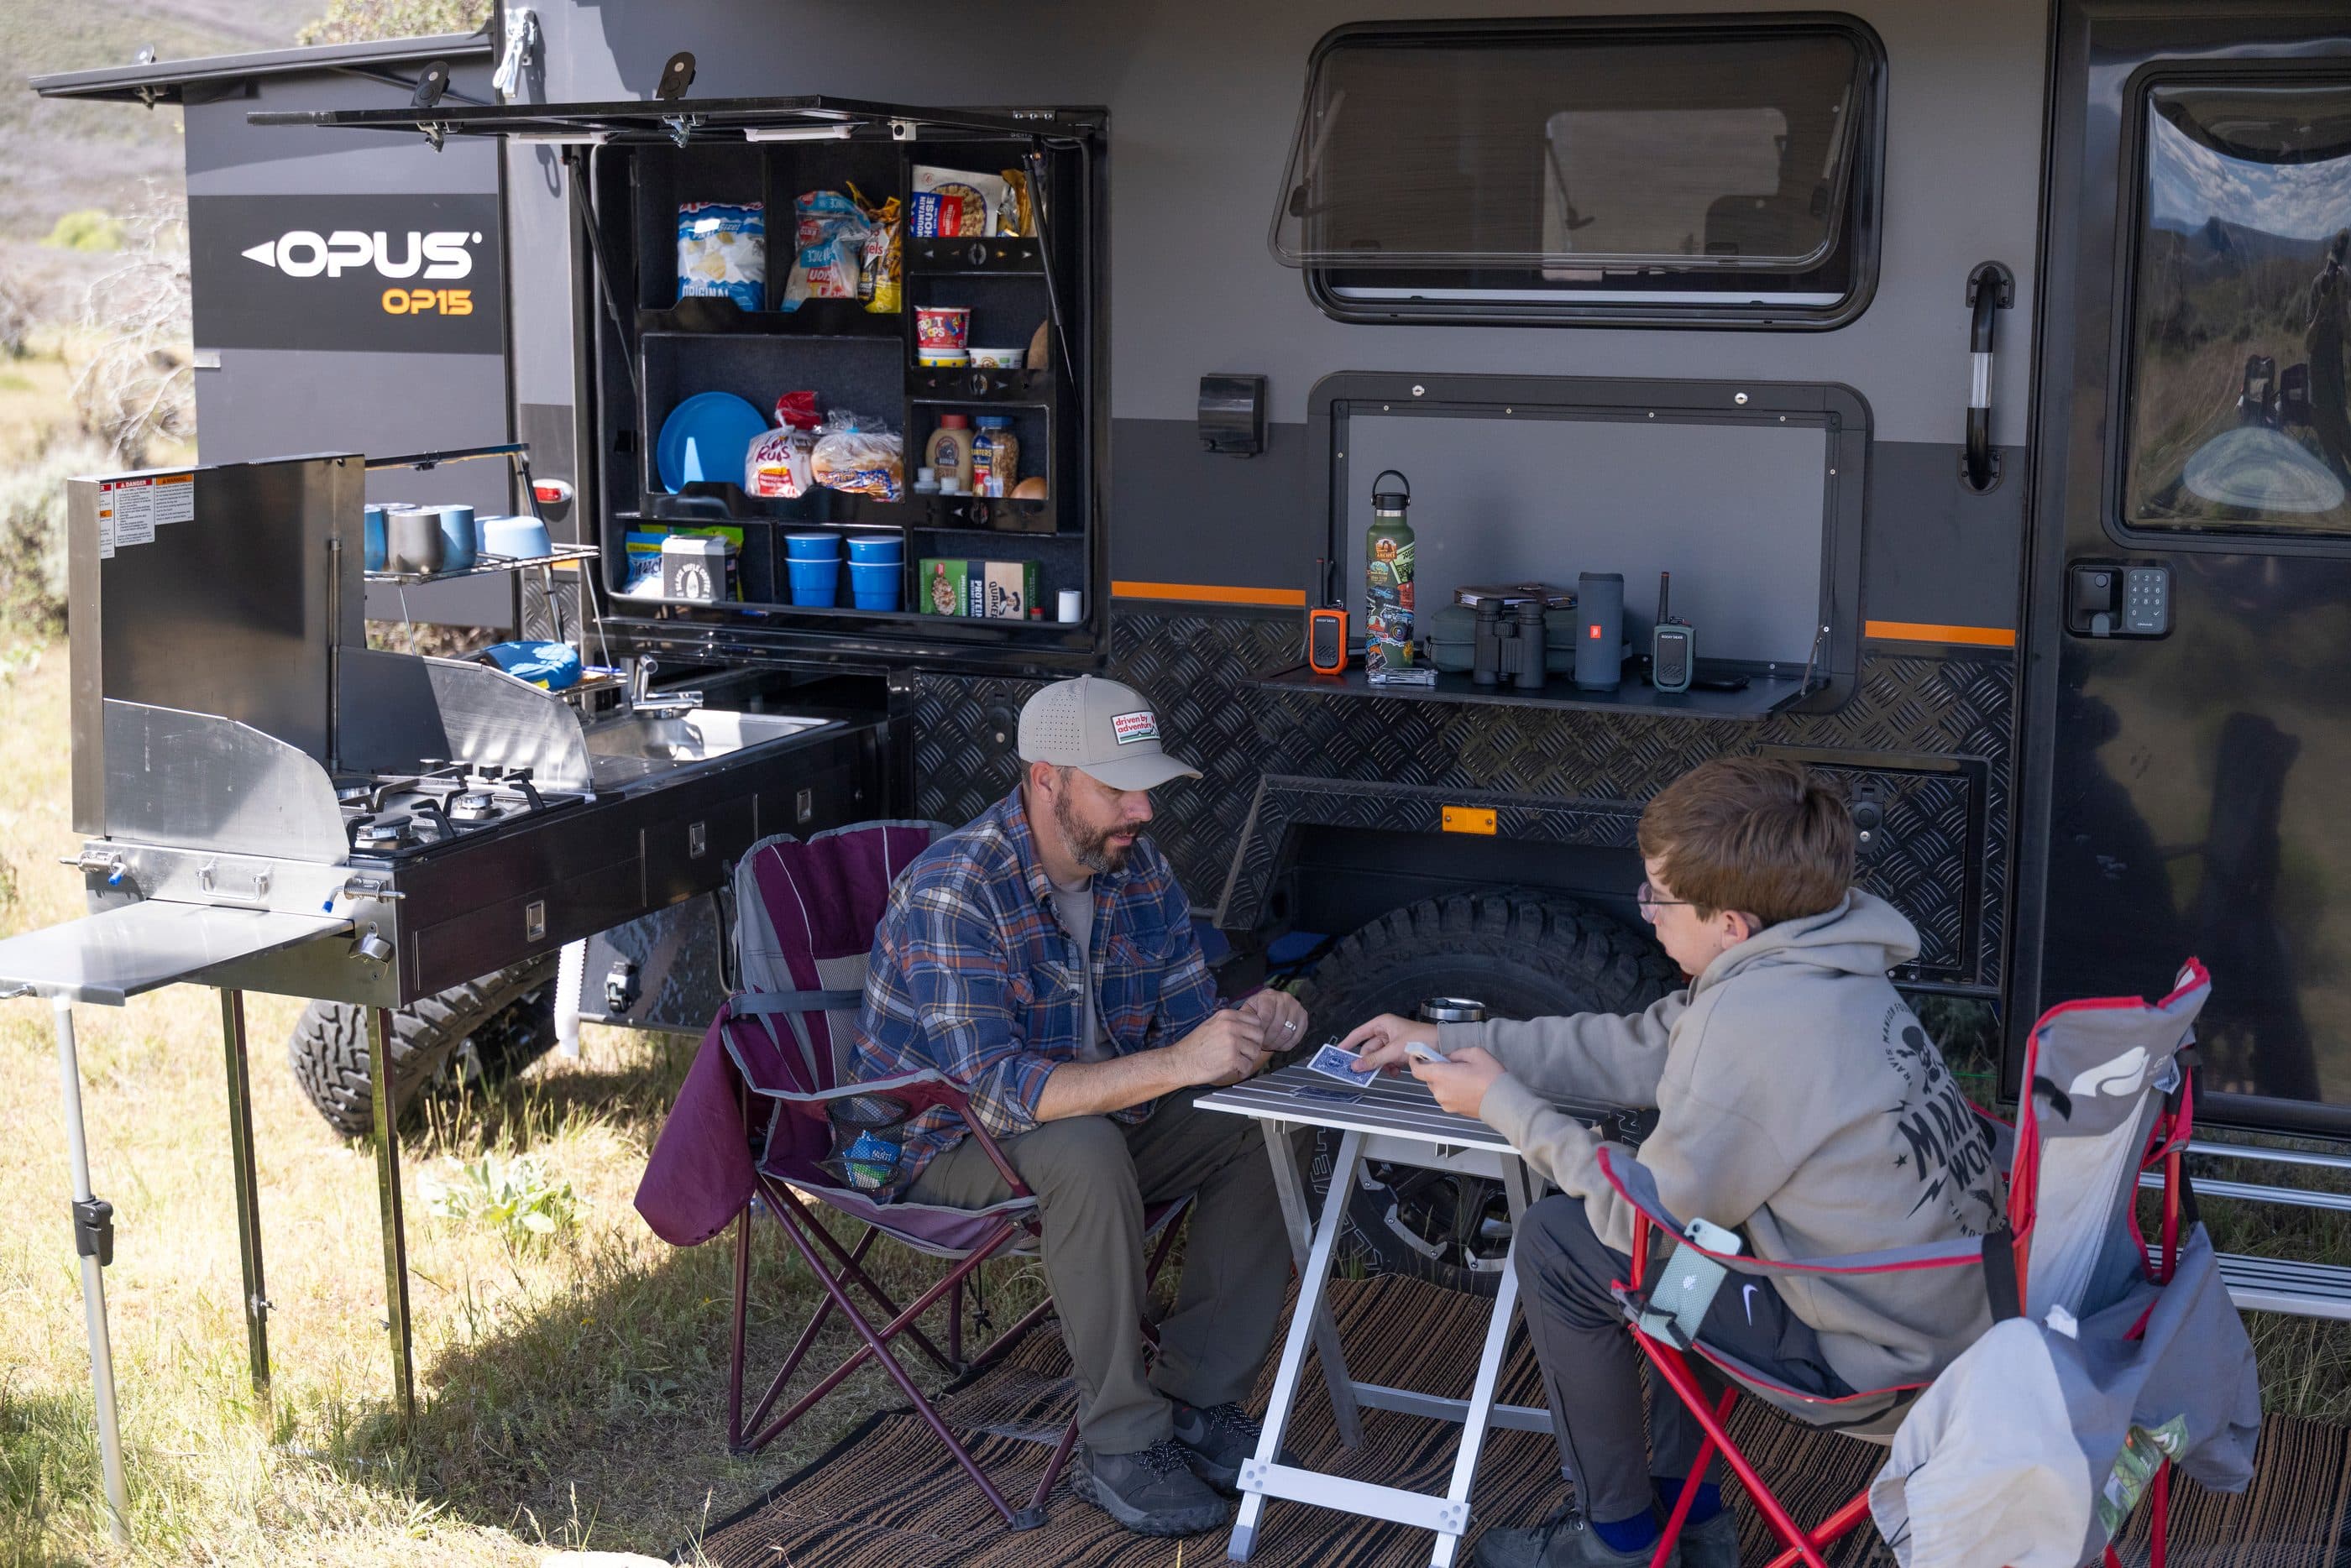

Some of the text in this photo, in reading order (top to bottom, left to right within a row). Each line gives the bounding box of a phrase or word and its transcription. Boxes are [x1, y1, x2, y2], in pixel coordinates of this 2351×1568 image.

[924, 196, 935, 237] HOUSE
[276, 230, 474, 280] OPUS
[382, 288, 474, 316] OP15
[1140, 713, 1148, 723] by
